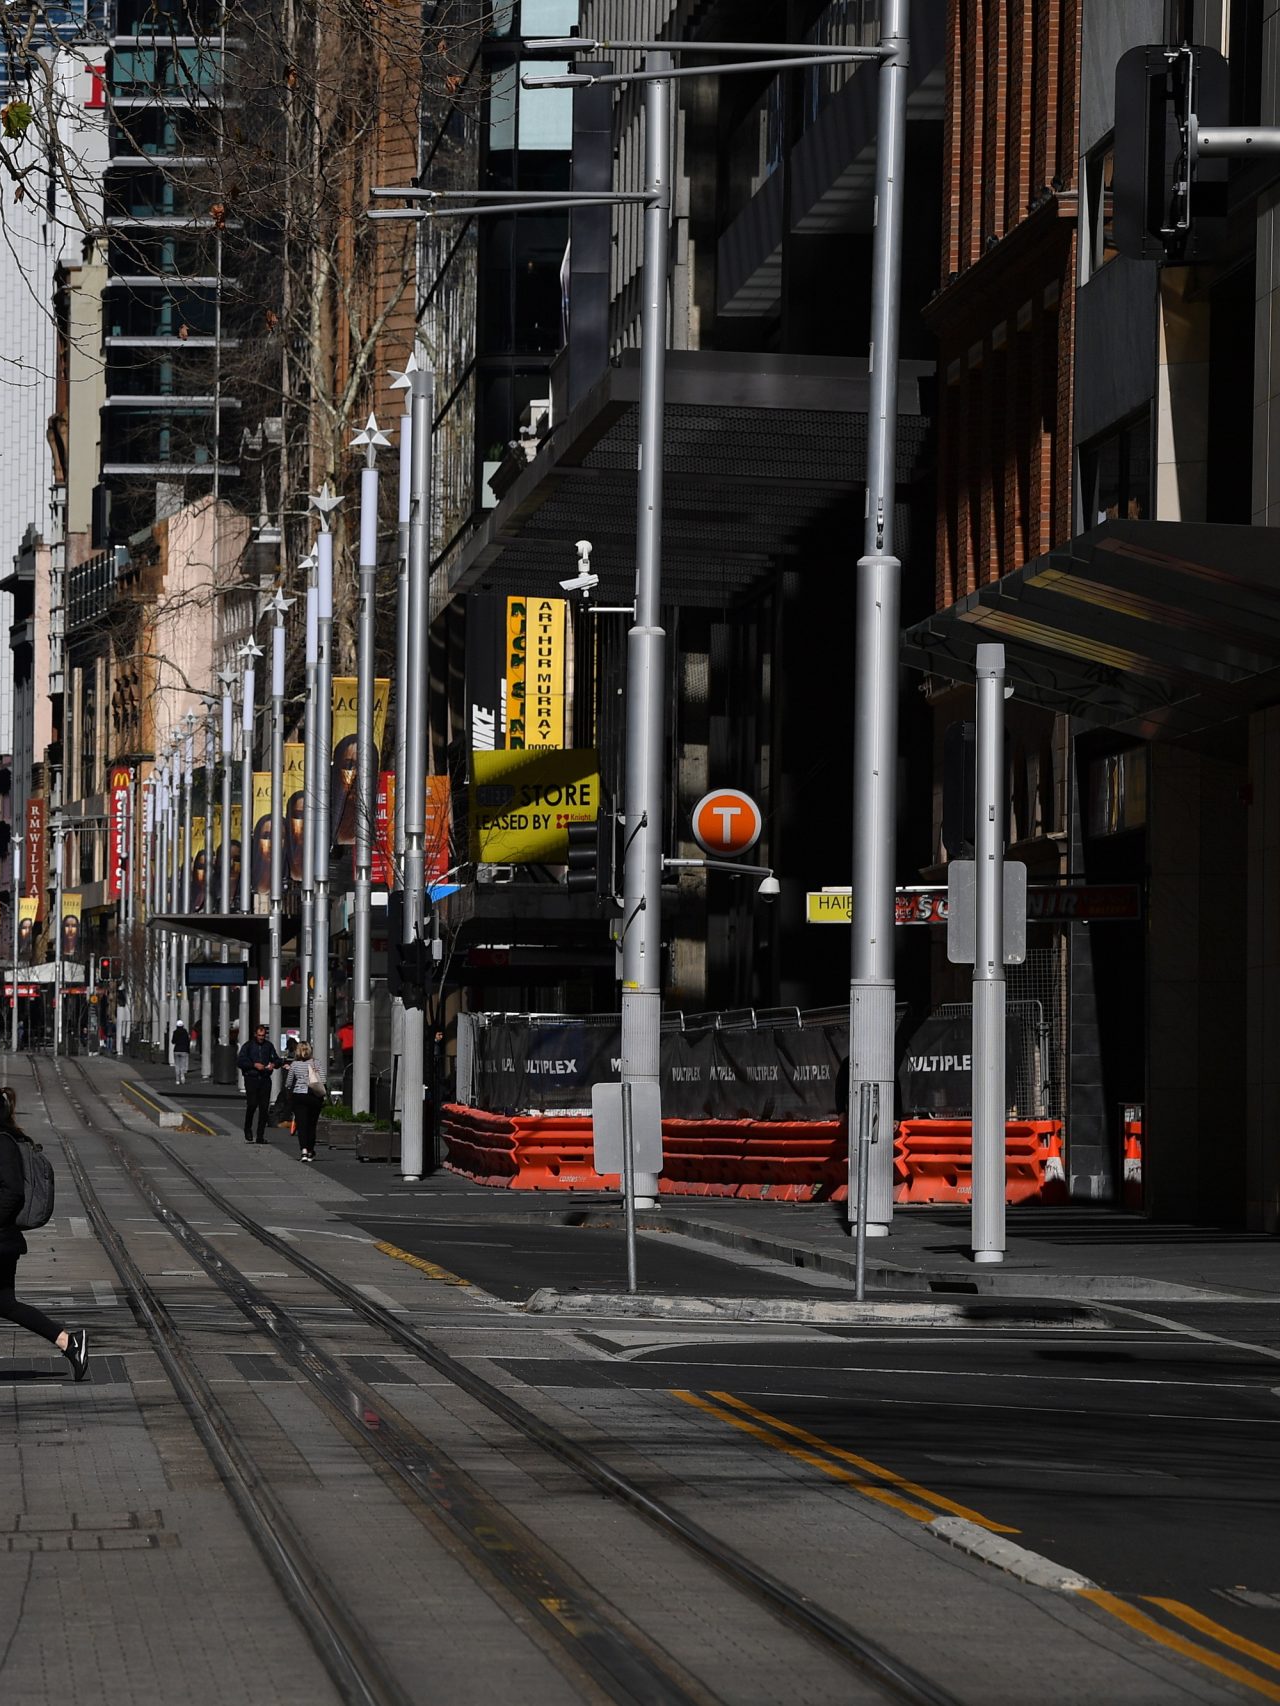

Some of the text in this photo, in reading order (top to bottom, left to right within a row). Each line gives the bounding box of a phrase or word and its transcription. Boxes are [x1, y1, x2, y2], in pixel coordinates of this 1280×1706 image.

[537, 601, 552, 668] ARTHUR
[537, 674, 552, 740] MURRAY
[472, 704, 495, 750] NIKE
[521, 784, 590, 806] STORE
[475, 814, 551, 830] LEASED BY
[570, 814, 591, 822] Knight
[712, 807, 741, 844] T
[895, 896, 910, 907] AX
[525, 1059, 577, 1074] ULTIPLEX
[907, 1055, 972, 1072] MULTIPLE
